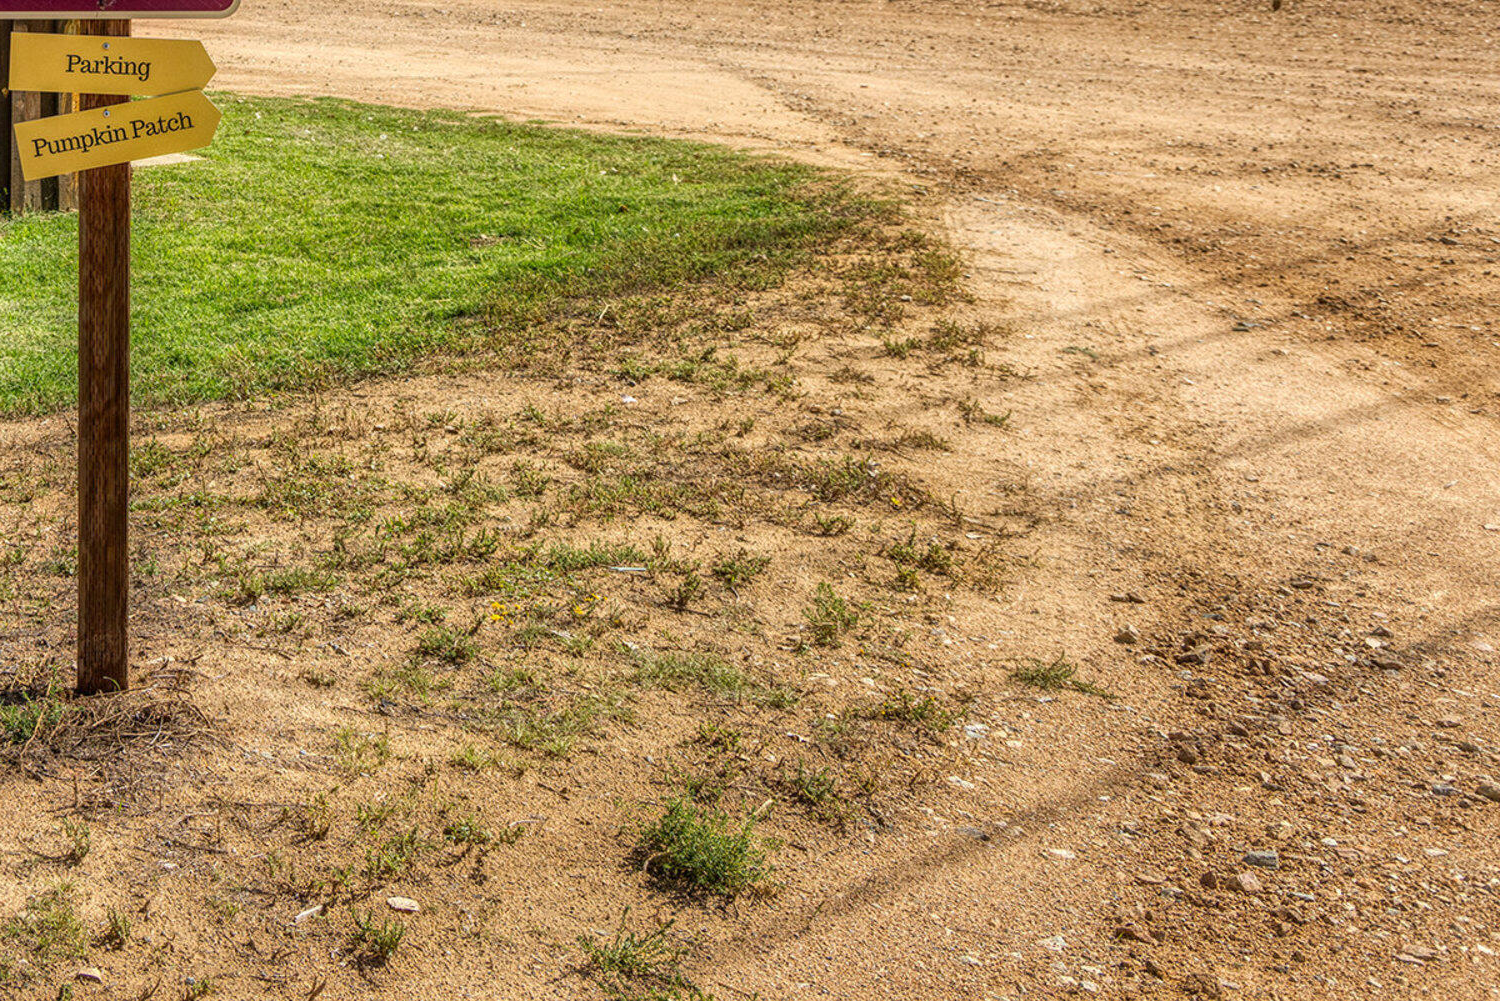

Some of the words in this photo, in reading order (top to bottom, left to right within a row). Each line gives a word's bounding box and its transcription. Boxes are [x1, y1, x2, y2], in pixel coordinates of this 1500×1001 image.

[65, 54, 151, 81] Parking
[32, 126, 128, 158] Pumpkin
[132, 111, 194, 139] Patch
